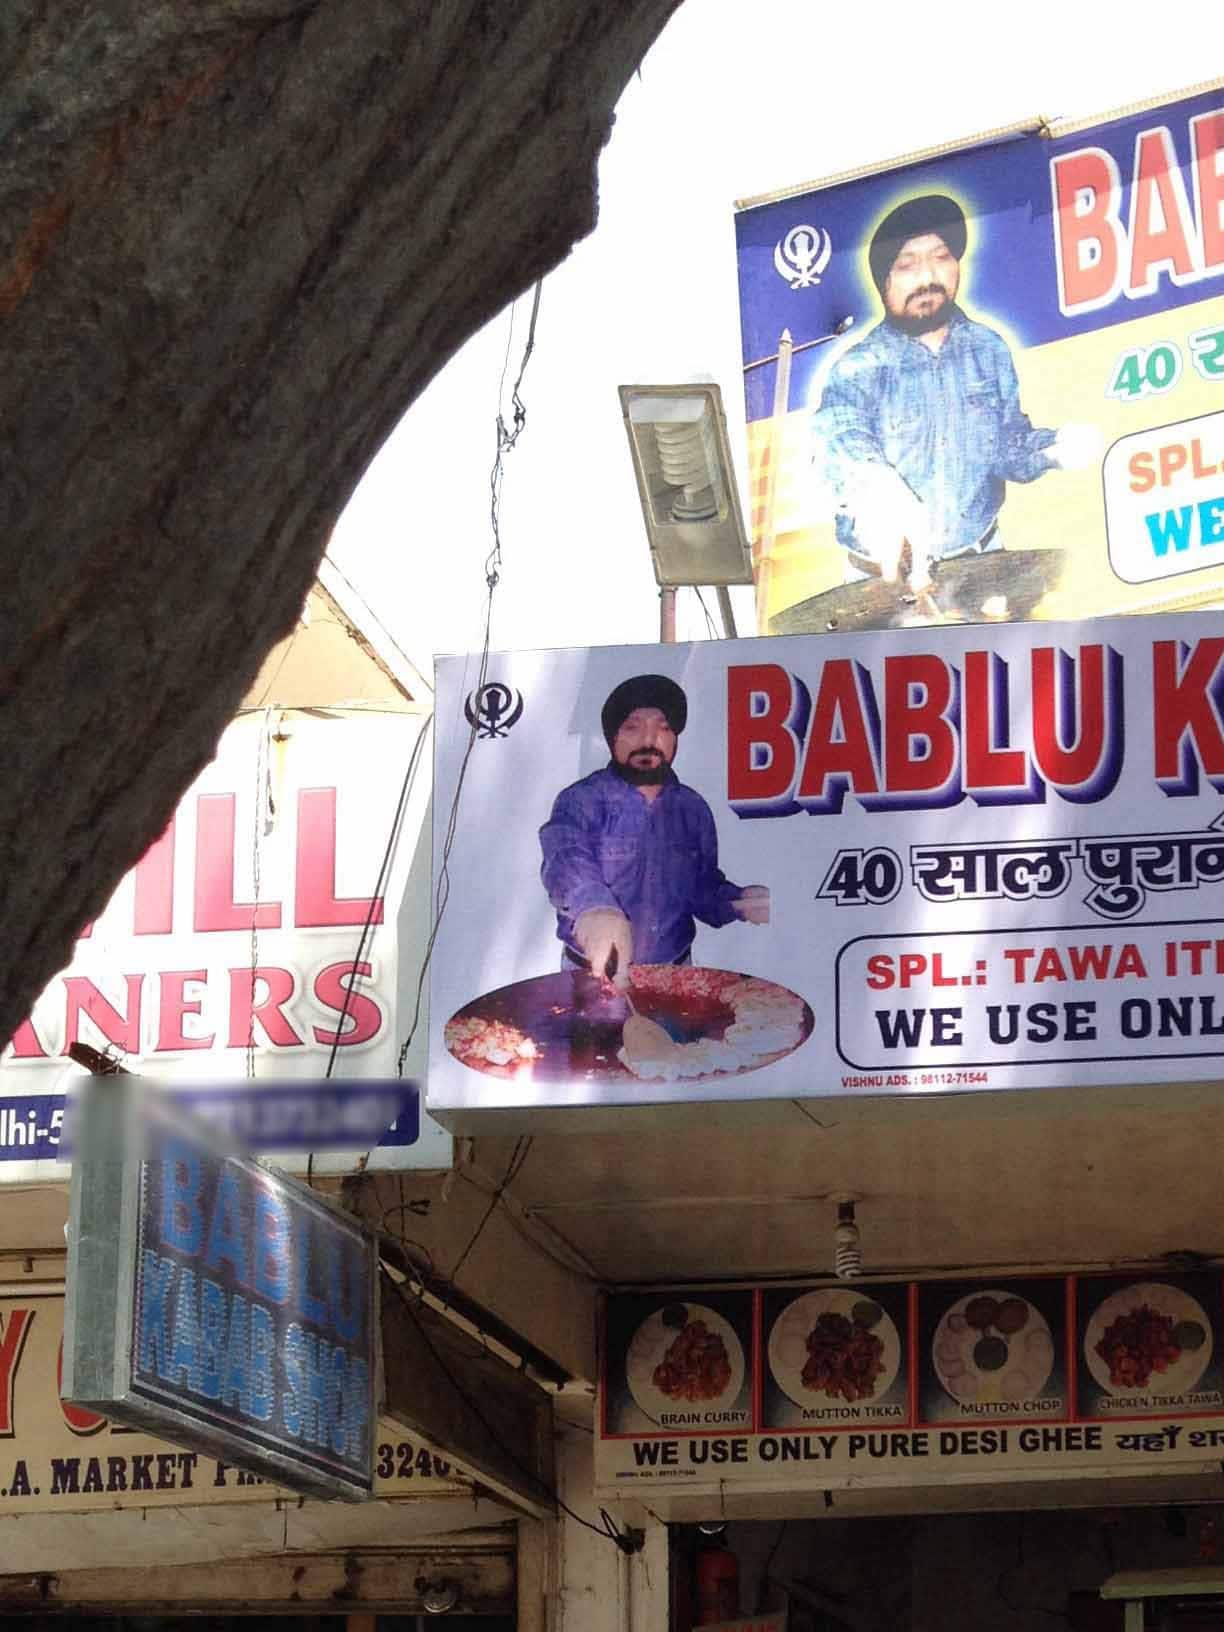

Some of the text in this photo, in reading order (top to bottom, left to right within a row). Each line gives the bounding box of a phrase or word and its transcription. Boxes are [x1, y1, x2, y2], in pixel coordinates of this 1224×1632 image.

[1110, 345, 1179, 397] 40
[726, 643, 1118, 815] BABLU
[816, 848, 902, 906] 40
[910, 842, 1077, 901] साल
[866, 954, 987, 991] SPL.:
[1003, 944, 1147, 985] TAWA
[875, 1007, 963, 1049] WE
[987, 1002, 1097, 1045] USE
[841, 1076, 882, 1088] VISHNU
[886, 1074, 911, 1087] ADS.
[159, 1136, 361, 1341] BABLU
[661, 1410, 746, 1426] BRAIN CURRY
[802, 1405, 902, 1421] MUTTON TIKKA
[960, 1399, 1061, 1415] MUTTON CHOP
[1100, 1392, 1222, 1409] CHICKEN TIKKA TAWA
[633, 1426, 1102, 1466] WE USE ONLY PURE DESI GHEE
[1116, 1419, 1177, 1452] यहाँ
[51, 1453, 198, 1491] MARKET
